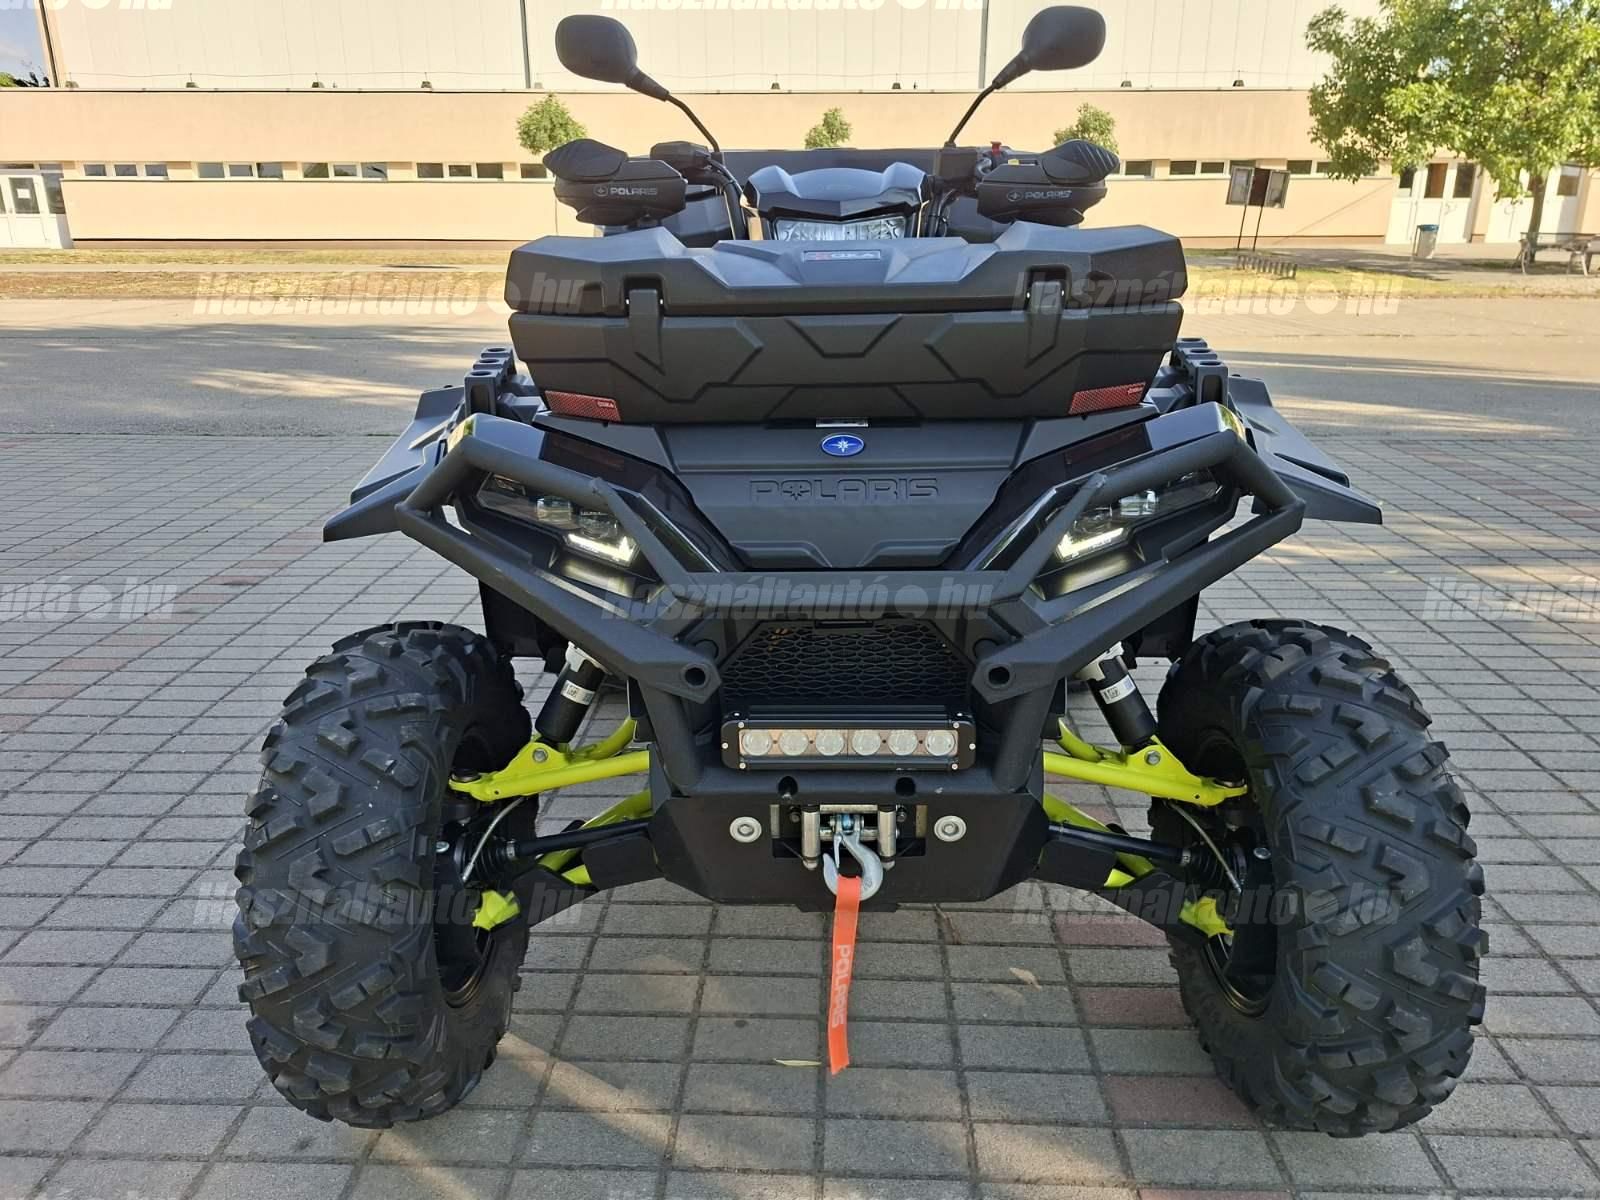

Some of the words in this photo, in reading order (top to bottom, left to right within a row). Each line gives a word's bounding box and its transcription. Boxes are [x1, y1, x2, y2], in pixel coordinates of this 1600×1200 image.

[609, 187, 657, 196] POLARIS
[1024, 190, 1072, 200] POLARIS
[749, 477, 939, 501] POLARIS
[831, 943, 851, 1029] POLARIS
